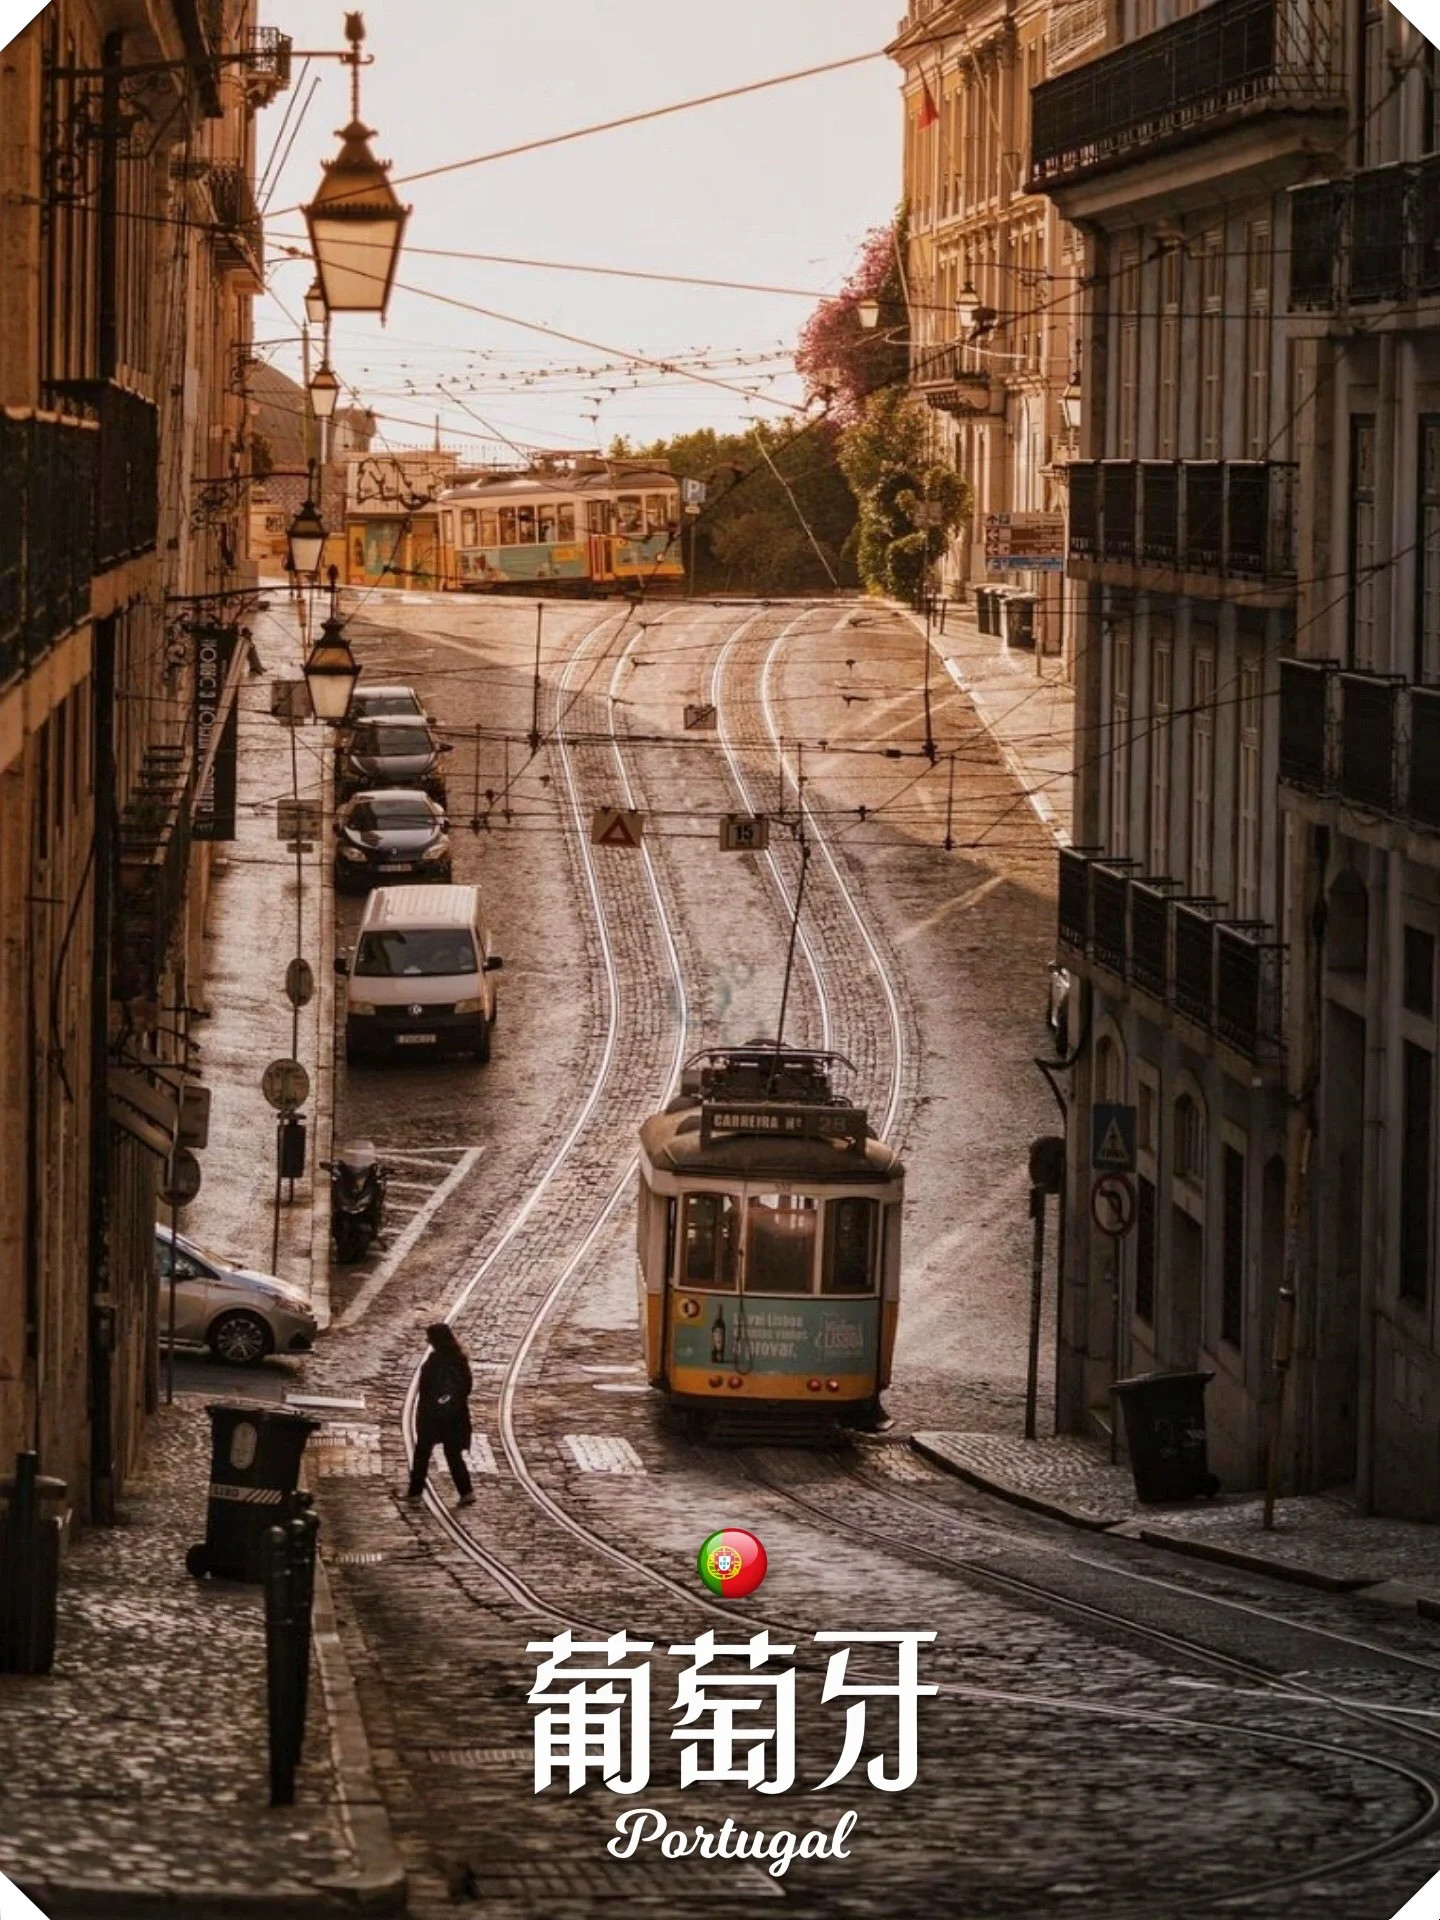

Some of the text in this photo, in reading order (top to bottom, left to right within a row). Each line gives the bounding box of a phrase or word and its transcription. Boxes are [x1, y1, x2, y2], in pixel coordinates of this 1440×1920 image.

[687, 479, 700, 499] P
[736, 824, 754, 840] 15
[713, 1113, 779, 1129] CARREIRA
